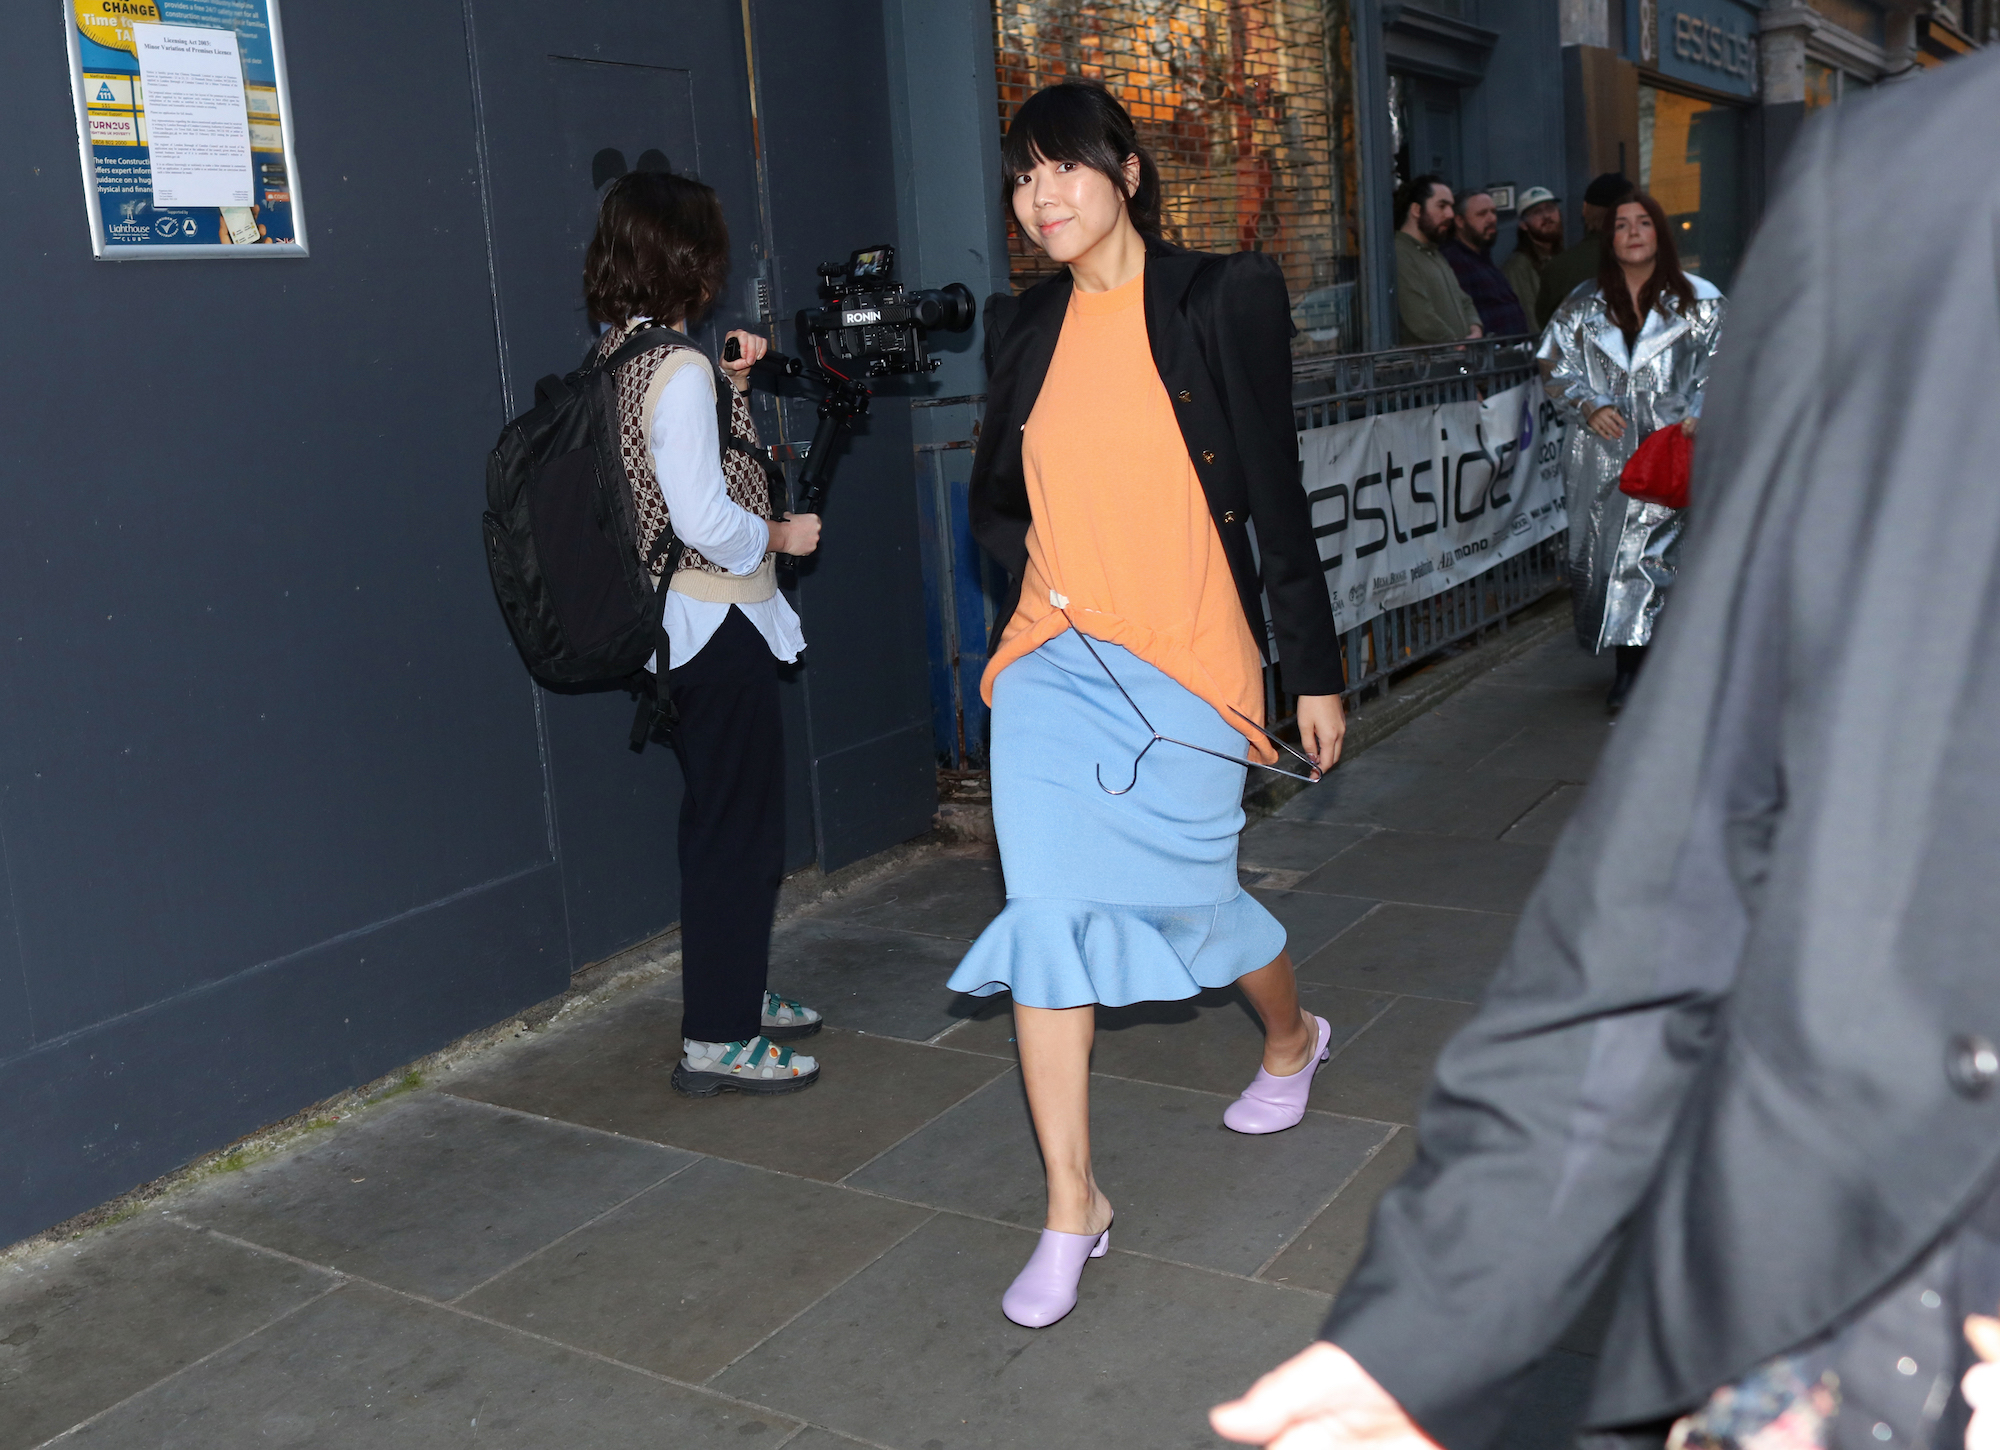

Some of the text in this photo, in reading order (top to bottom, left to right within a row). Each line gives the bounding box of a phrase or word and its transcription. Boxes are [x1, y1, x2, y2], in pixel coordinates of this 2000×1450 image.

[102, 1, 156, 17] CHANGE
[164, 1, 189, 10] provides
[194, 4, 205, 12] free
[244, 10, 252, 18] for
[83, 13, 134, 28] Time to
[165, 11, 201, 20] construction
[201, 15, 221, 23] workers
[163, 37, 188, 46] Licensing
[161, 44, 185, 52] Variation
[191, 47, 213, 55] Premises
[214, 48, 232, 56] Licence
[99, 92, 111, 100] 111
[89, 120, 130, 130] TURN2US
[104, 157, 117, 165] free
[112, 167, 132, 175] expert
[109, 223, 150, 233] Lighthouse
[846, 310, 882, 324] RONIN
[1298, 424, 1518, 572] estside
[1454, 538, 1488, 560] mono
